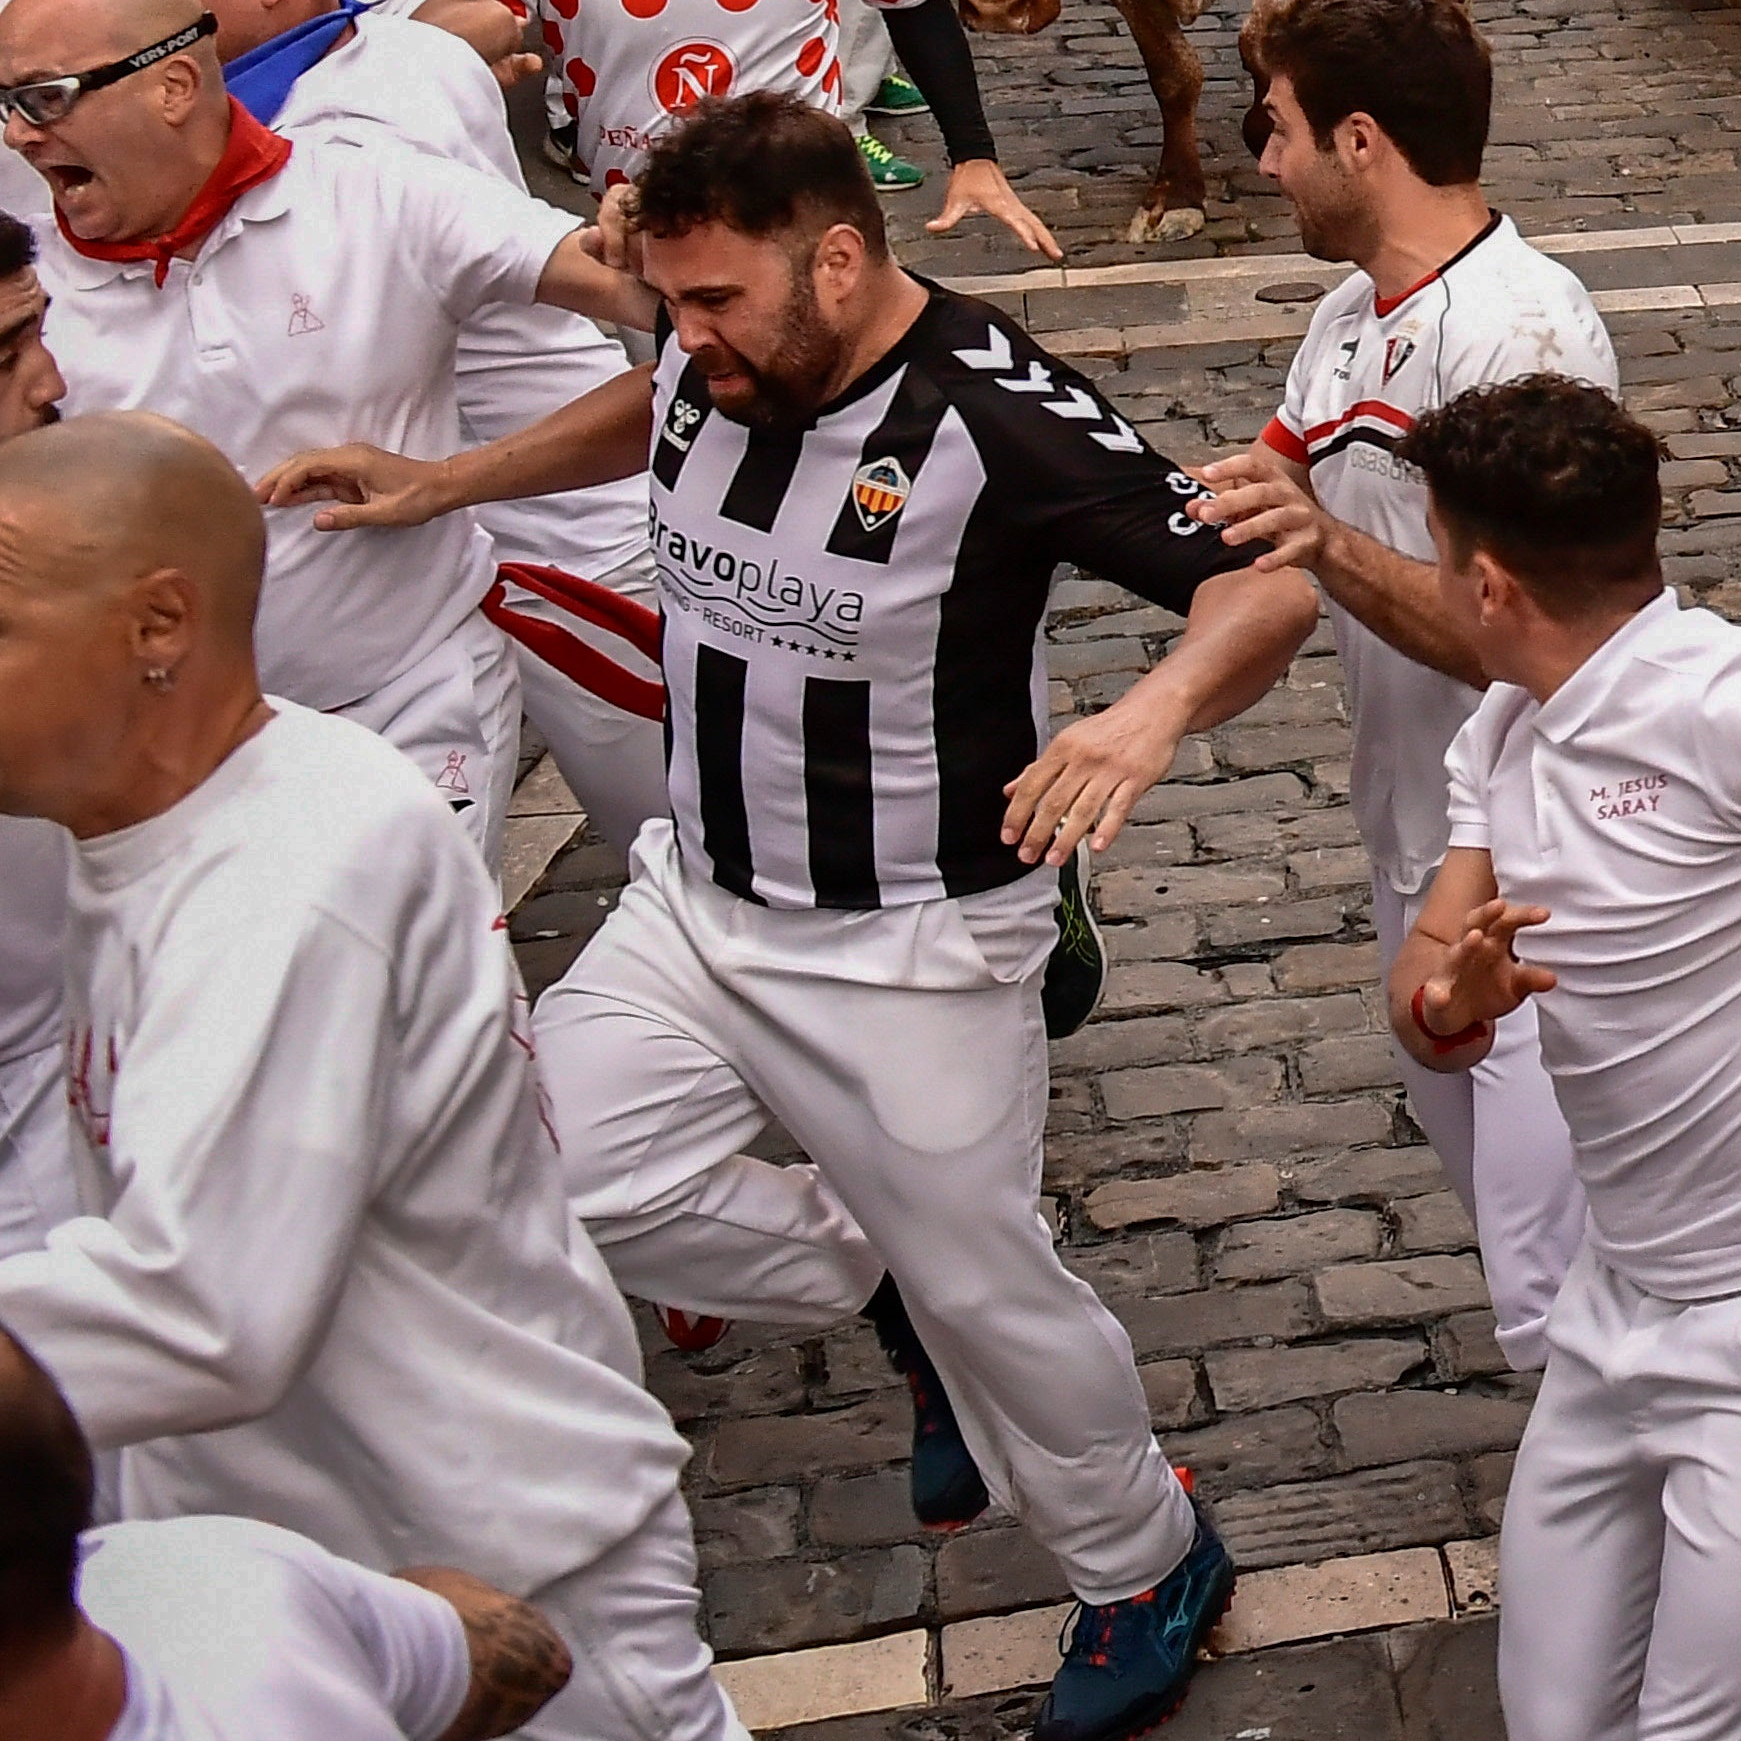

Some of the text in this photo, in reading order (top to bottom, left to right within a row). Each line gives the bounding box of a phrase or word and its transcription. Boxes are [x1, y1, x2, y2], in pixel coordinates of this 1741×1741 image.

[702, 606, 766, 644] RESORT
[1617, 773, 1668, 798] JESUS
[1597, 794, 1660, 821] SARAY
